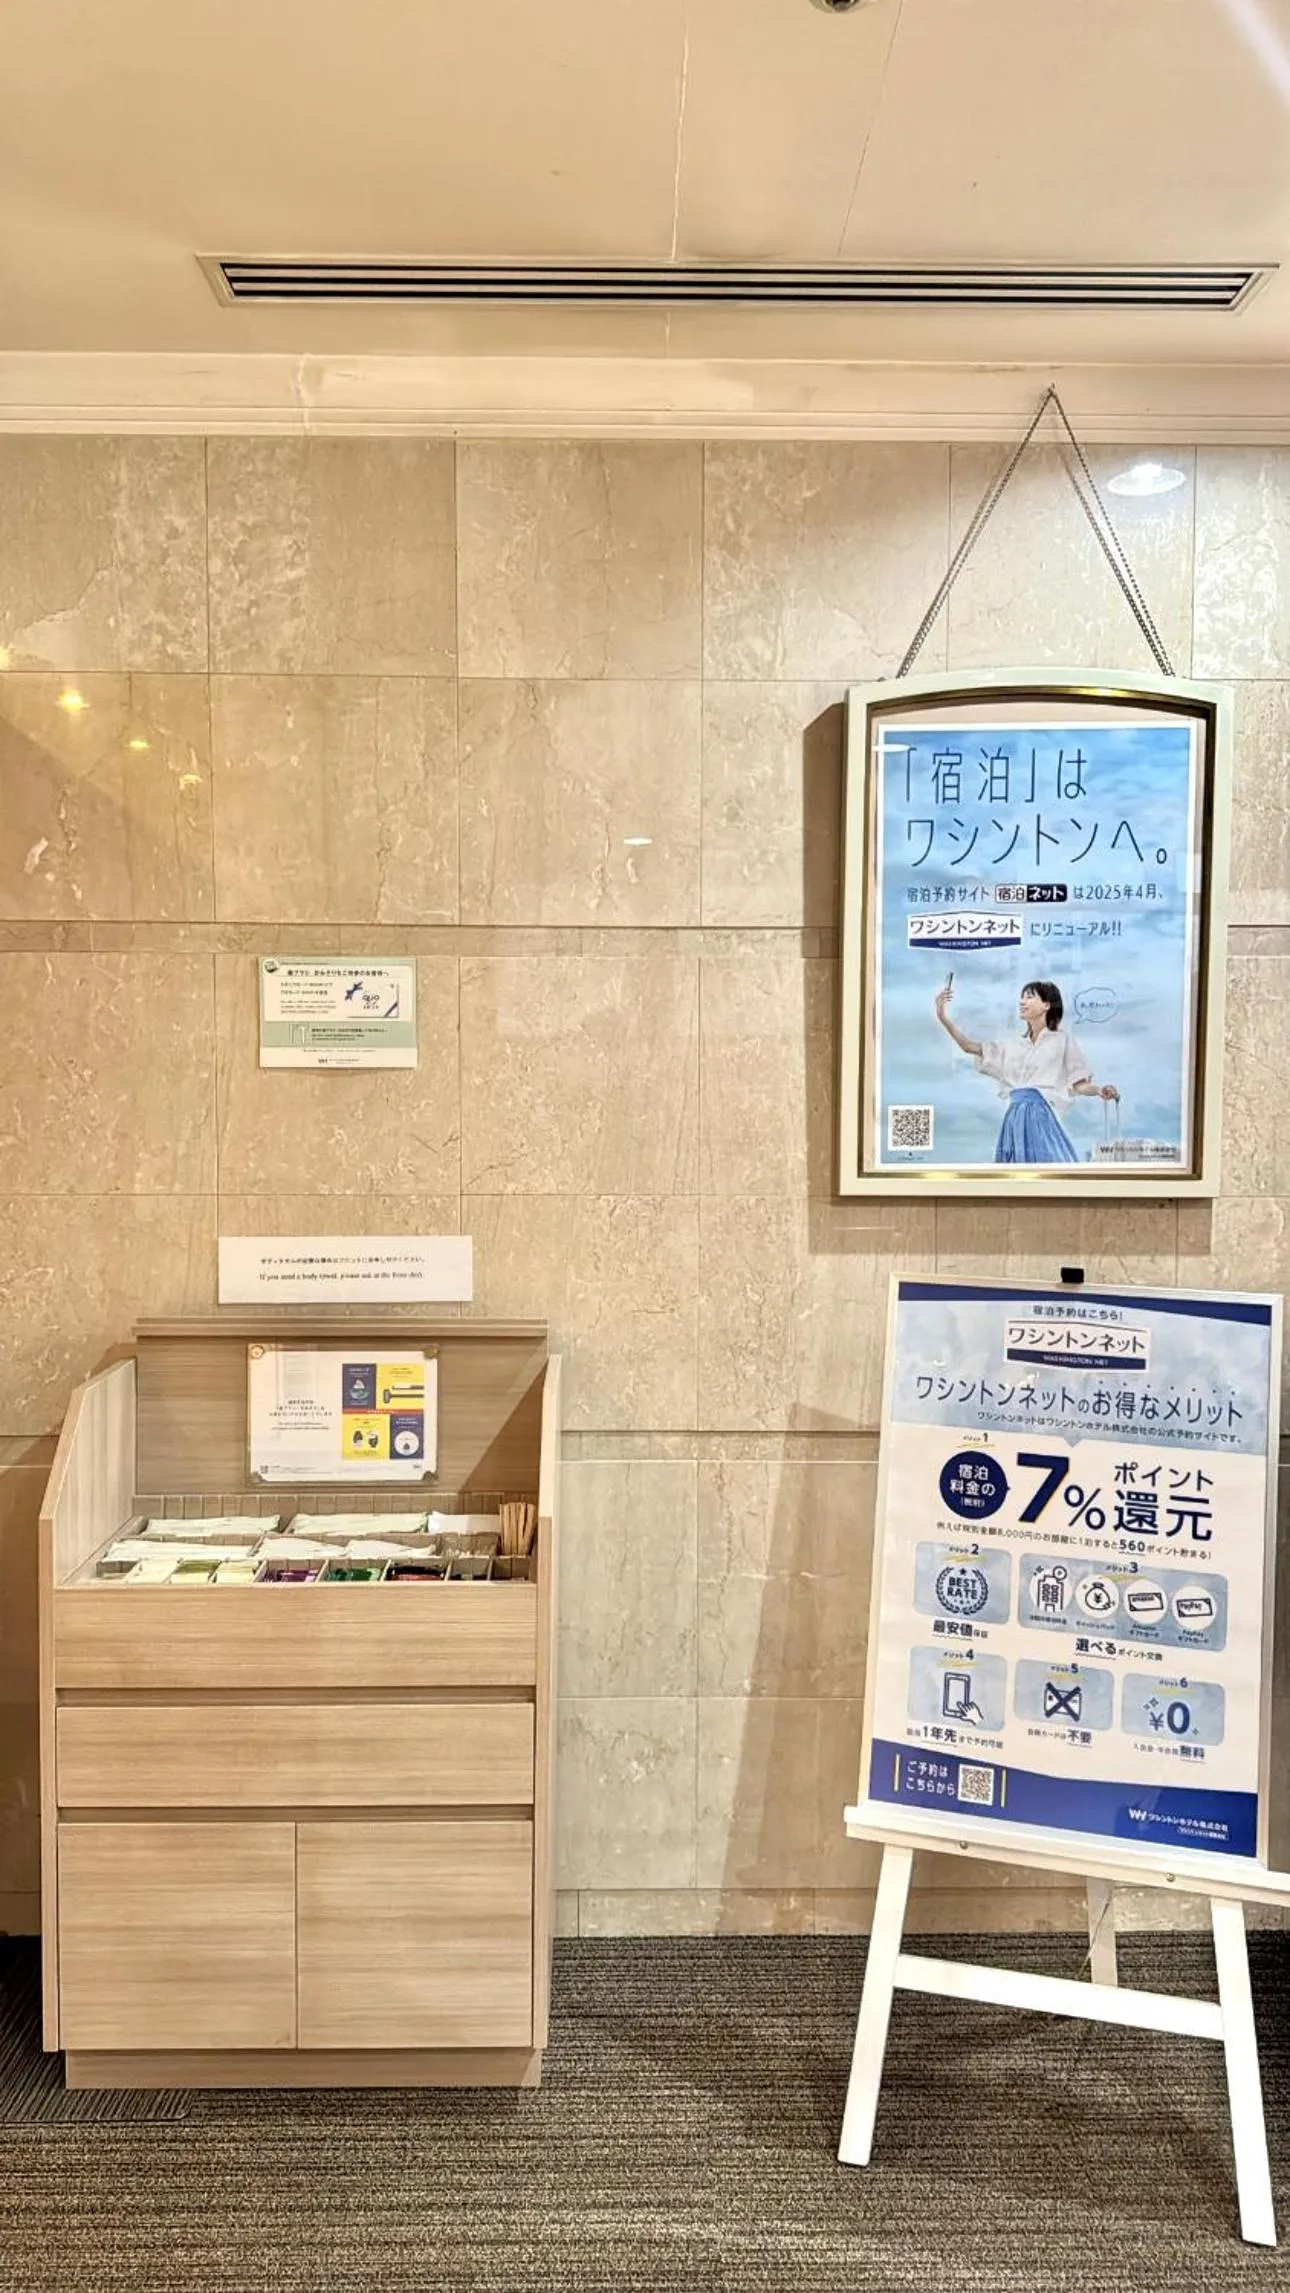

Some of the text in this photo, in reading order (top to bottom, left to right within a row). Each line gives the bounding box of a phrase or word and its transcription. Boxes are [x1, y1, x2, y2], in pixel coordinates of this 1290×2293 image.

[906, 747, 1087, 804] 「宿泊」は
[907, 813, 1168, 867] ワシントンへ。
[907, 886, 990, 903] 宿泊予約サイト
[909, 917, 1020, 936] ワシントンネット
[1008, 1327, 1146, 1354] ワシントンネット
[916, 1376, 1243, 1428] ワシントンネットのお得なメリット
[959, 1463, 989, 1481] 宿泊
[1113, 1461, 1215, 1492] ポイント
[949, 1478, 996, 1497] 料金の
[1113, 1488, 1213, 1542] 還元
[949, 1577, 977, 1589] BEST
[947, 1587, 978, 1600] RATE
[907, 1760, 948, 1778] ご予約は
[906, 1777, 956, 1796] こちらから
